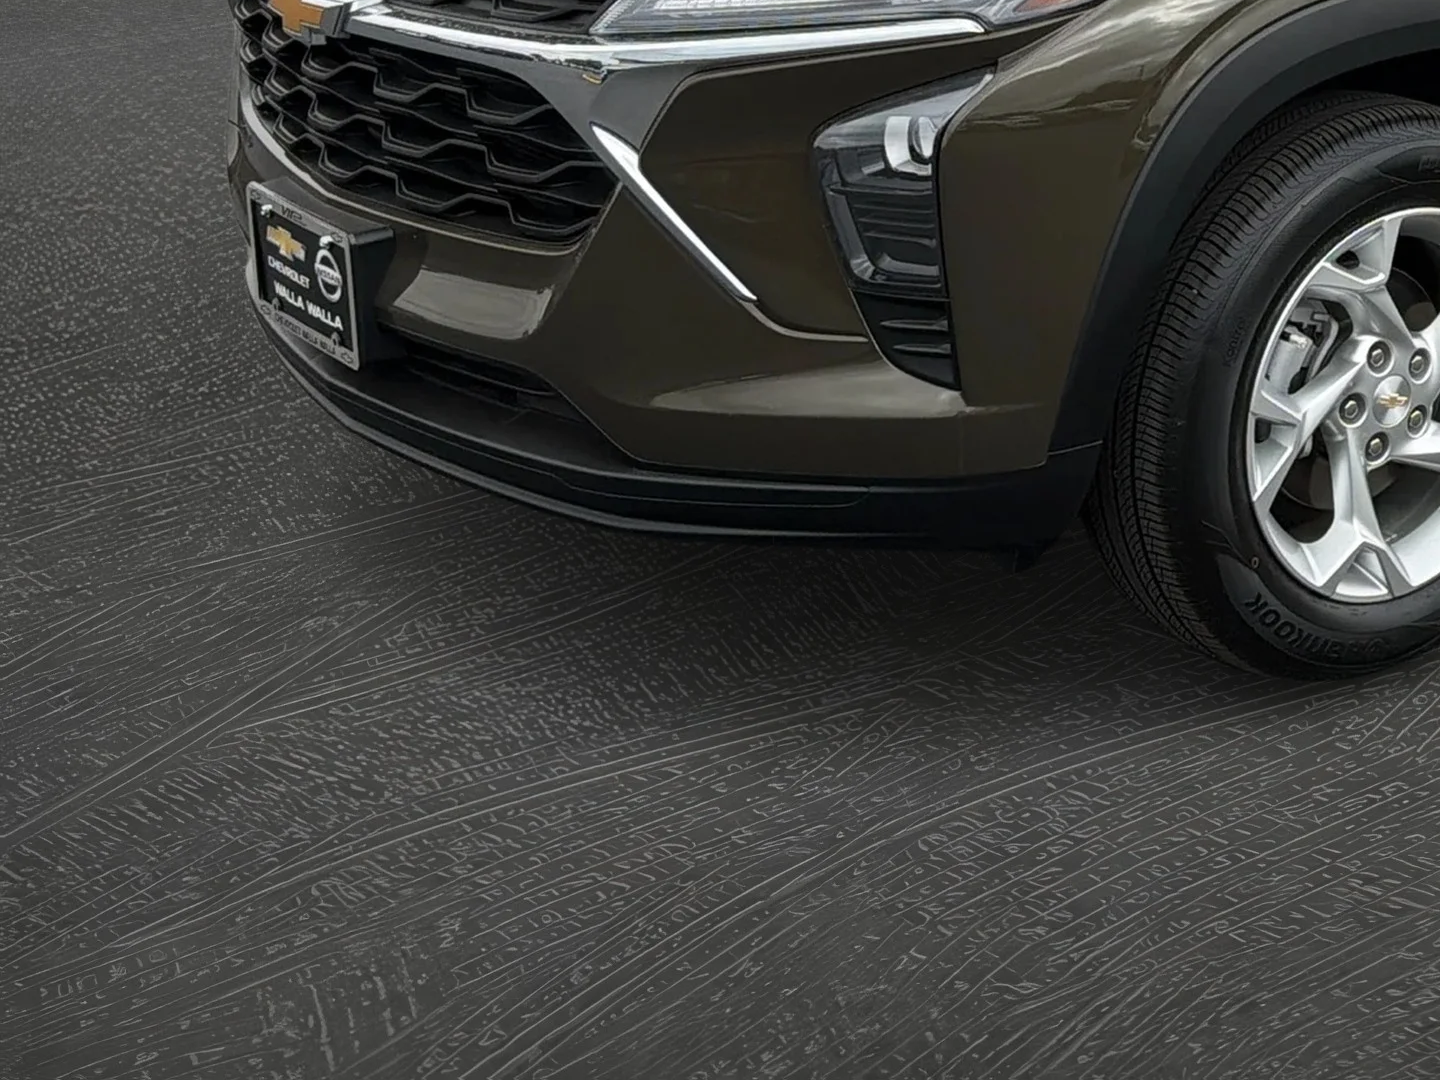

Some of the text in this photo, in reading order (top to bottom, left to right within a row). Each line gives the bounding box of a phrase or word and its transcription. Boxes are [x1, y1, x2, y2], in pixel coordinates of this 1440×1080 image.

[267, 255, 310, 289] CHEVROLET
[273, 280, 344, 331] WALLA WALLA
